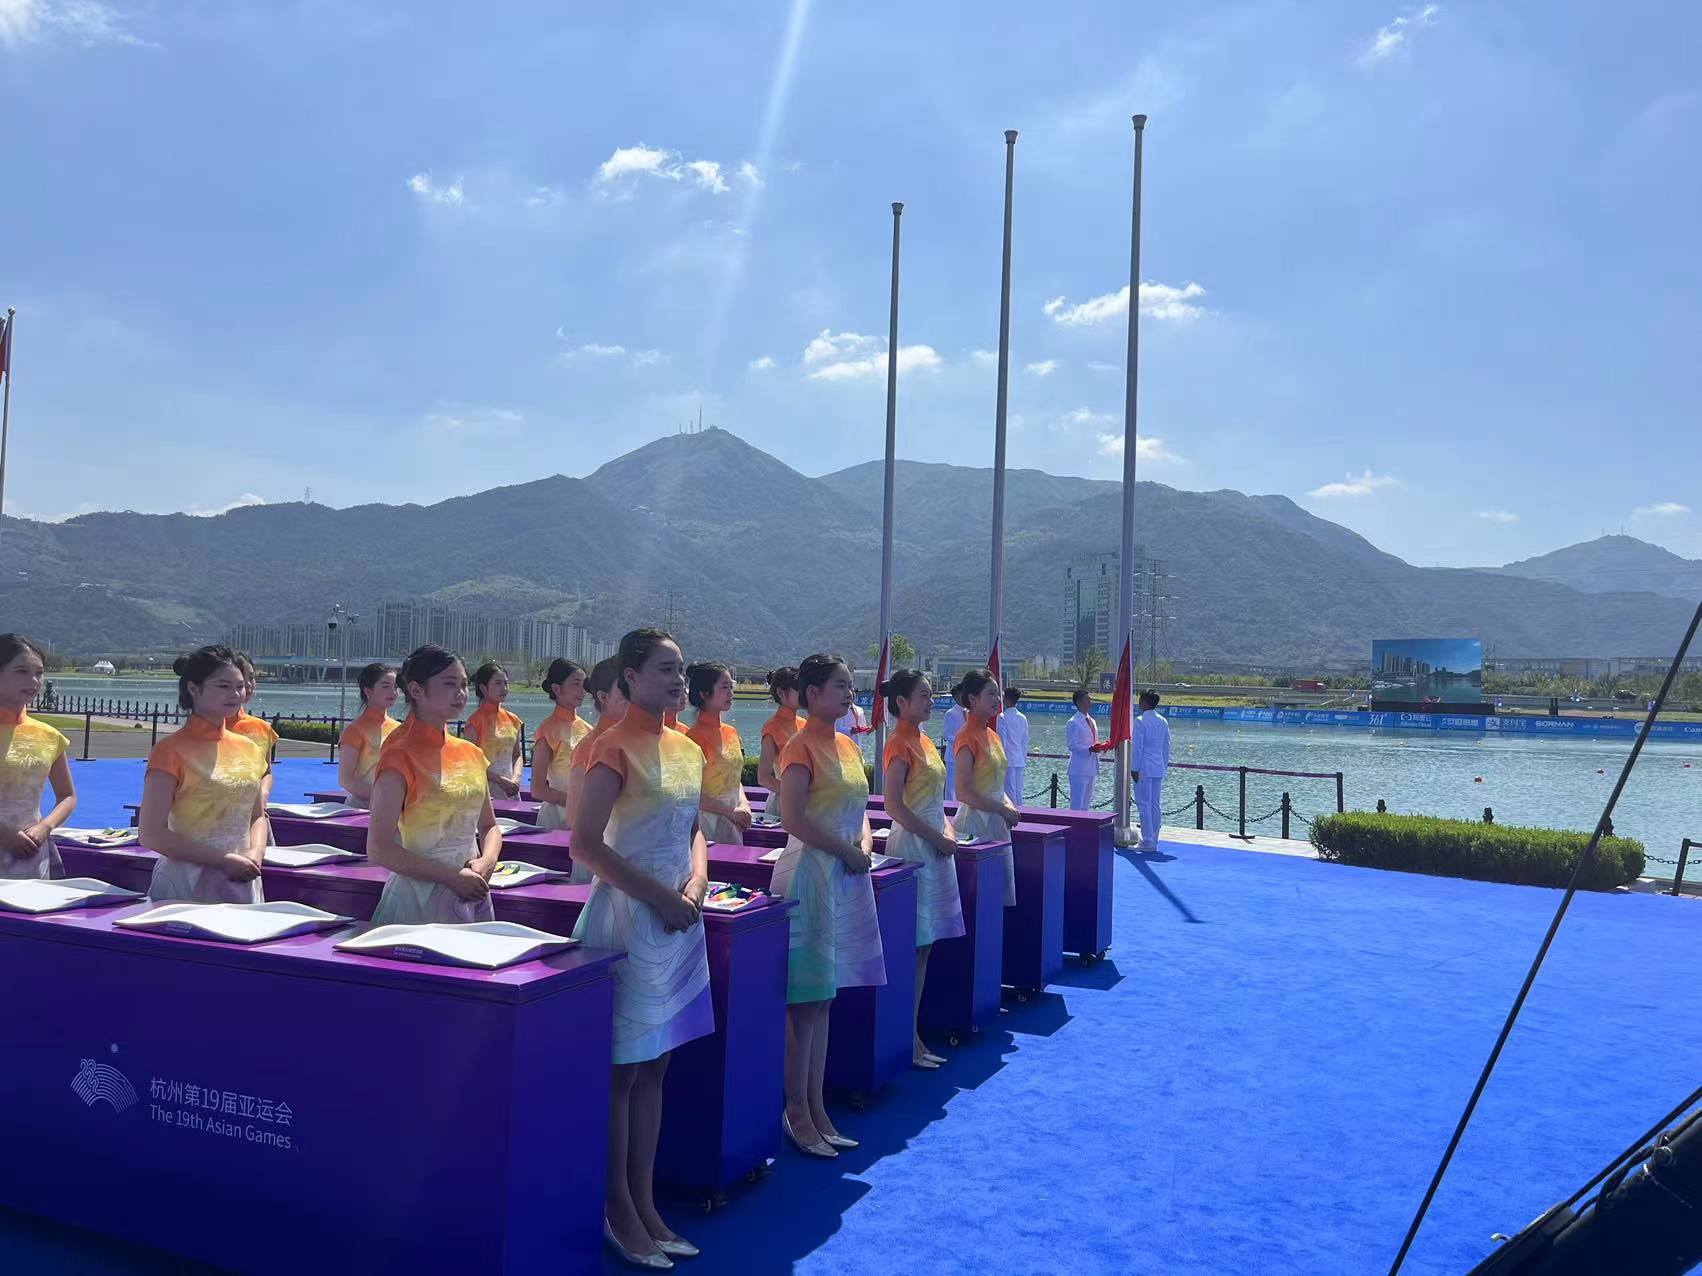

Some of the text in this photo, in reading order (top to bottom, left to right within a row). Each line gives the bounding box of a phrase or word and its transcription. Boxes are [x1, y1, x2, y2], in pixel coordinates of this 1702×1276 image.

[1502, 717, 1528, 727] 支付宝
[1535, 720, 1574, 729] BORNAN
[1683, 726, 1702, 734] Can
[149, 1076, 293, 1127] 杭州第19届亚运会
[149, 1104, 293, 1151] The 19th Asian Games
